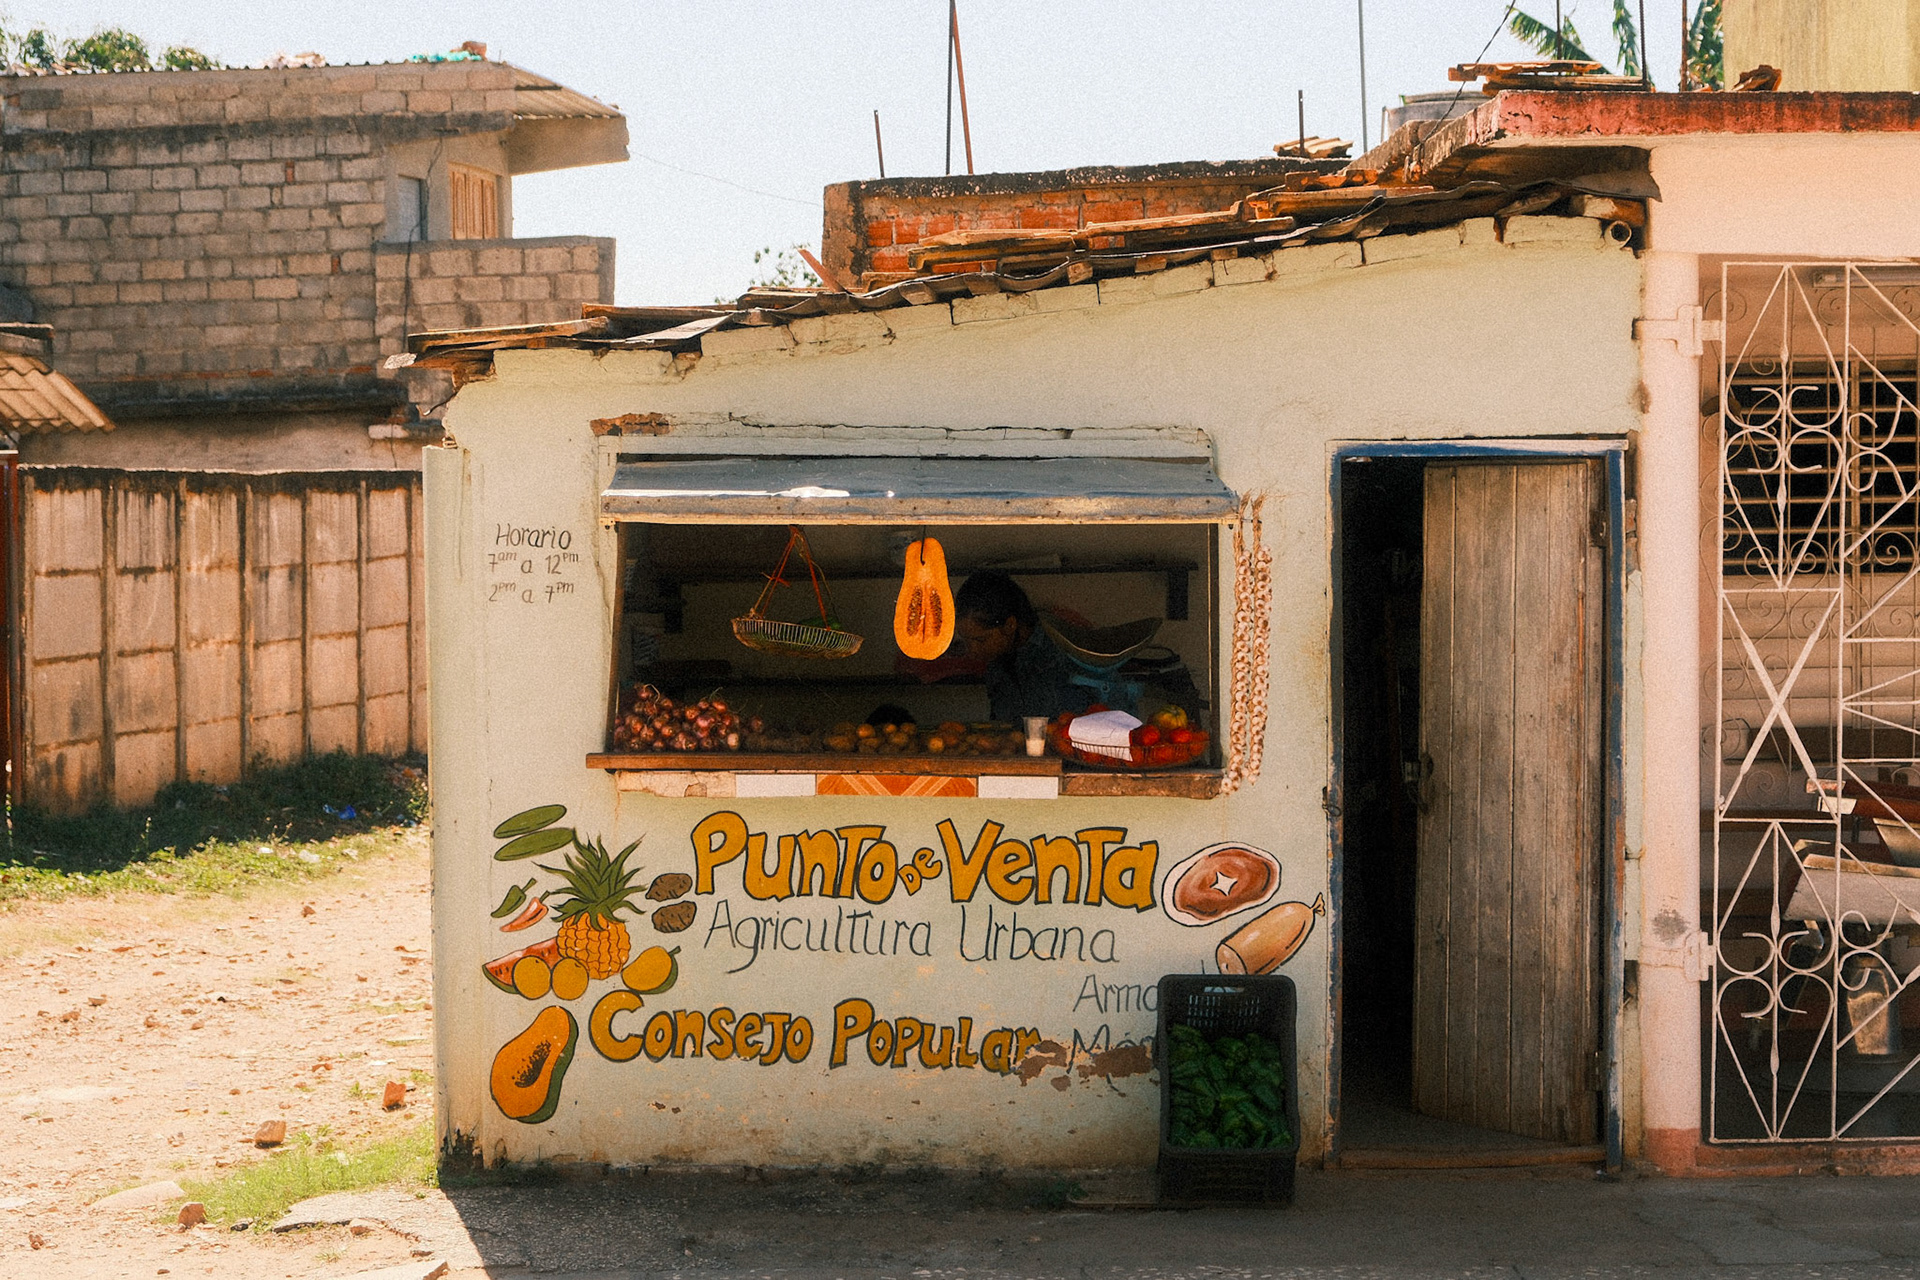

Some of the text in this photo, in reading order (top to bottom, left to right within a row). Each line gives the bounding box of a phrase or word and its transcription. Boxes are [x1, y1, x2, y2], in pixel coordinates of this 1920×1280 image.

[495, 523, 572, 550] Horario
[520, 558, 533, 574] a
[545, 551, 579, 575] 12pm
[521, 588, 534, 604] a
[704, 899, 1120, 974] Agricultura Urbana
